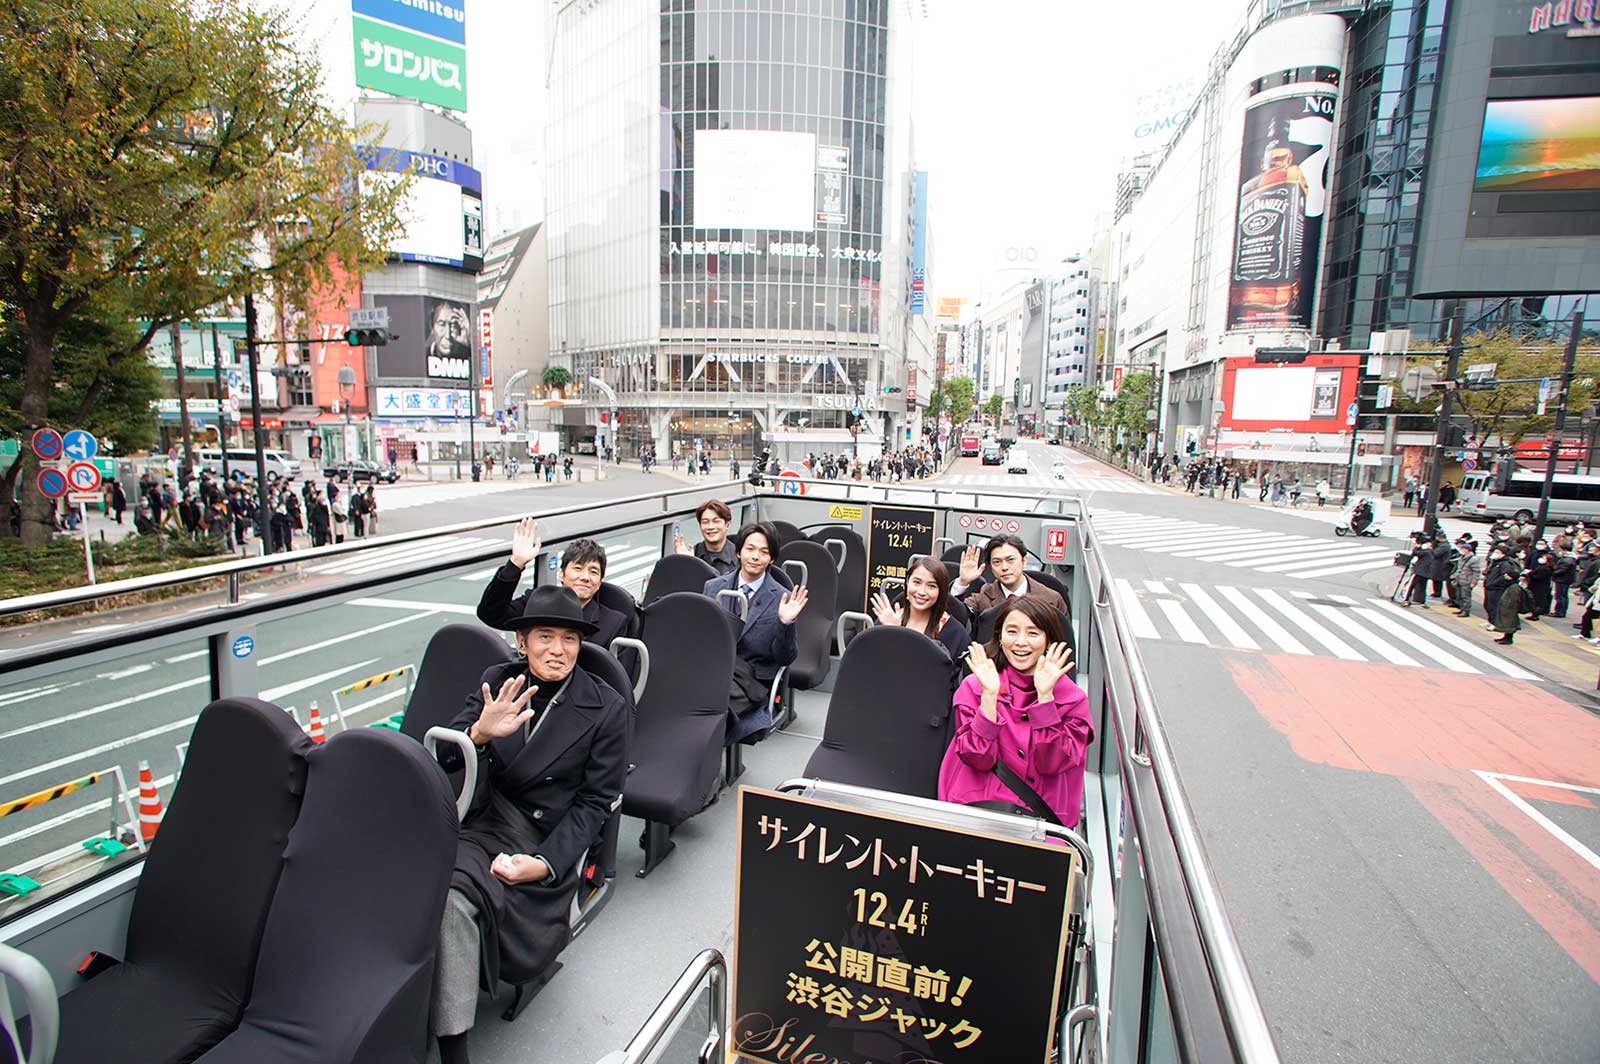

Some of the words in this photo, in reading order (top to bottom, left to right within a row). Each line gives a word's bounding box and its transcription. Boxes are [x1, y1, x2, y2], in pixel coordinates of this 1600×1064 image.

[392, 0, 464, 22] mitsu
[361, 37, 461, 91] サロンパス
[1303, 96, 1334, 113] No.
[410, 154, 448, 176] DHC
[912, 267, 924, 305] SEIBU
[428, 355, 470, 379] DMM
[707, 352, 780, 363] STARBUCKS
[786, 353, 829, 364] COFFEE
[815, 395, 877, 409] TSUTAYA
[887, 533, 909, 549] 12.4
[758, 815, 1047, 905] サイレント・トーキョー
[853, 887, 917, 935] 12.4
[920, 902, 929, 937] FRI
[803, 938, 974, 1007] 公開直前！
[785, 971, 983, 1050] 渋谷ジャック
